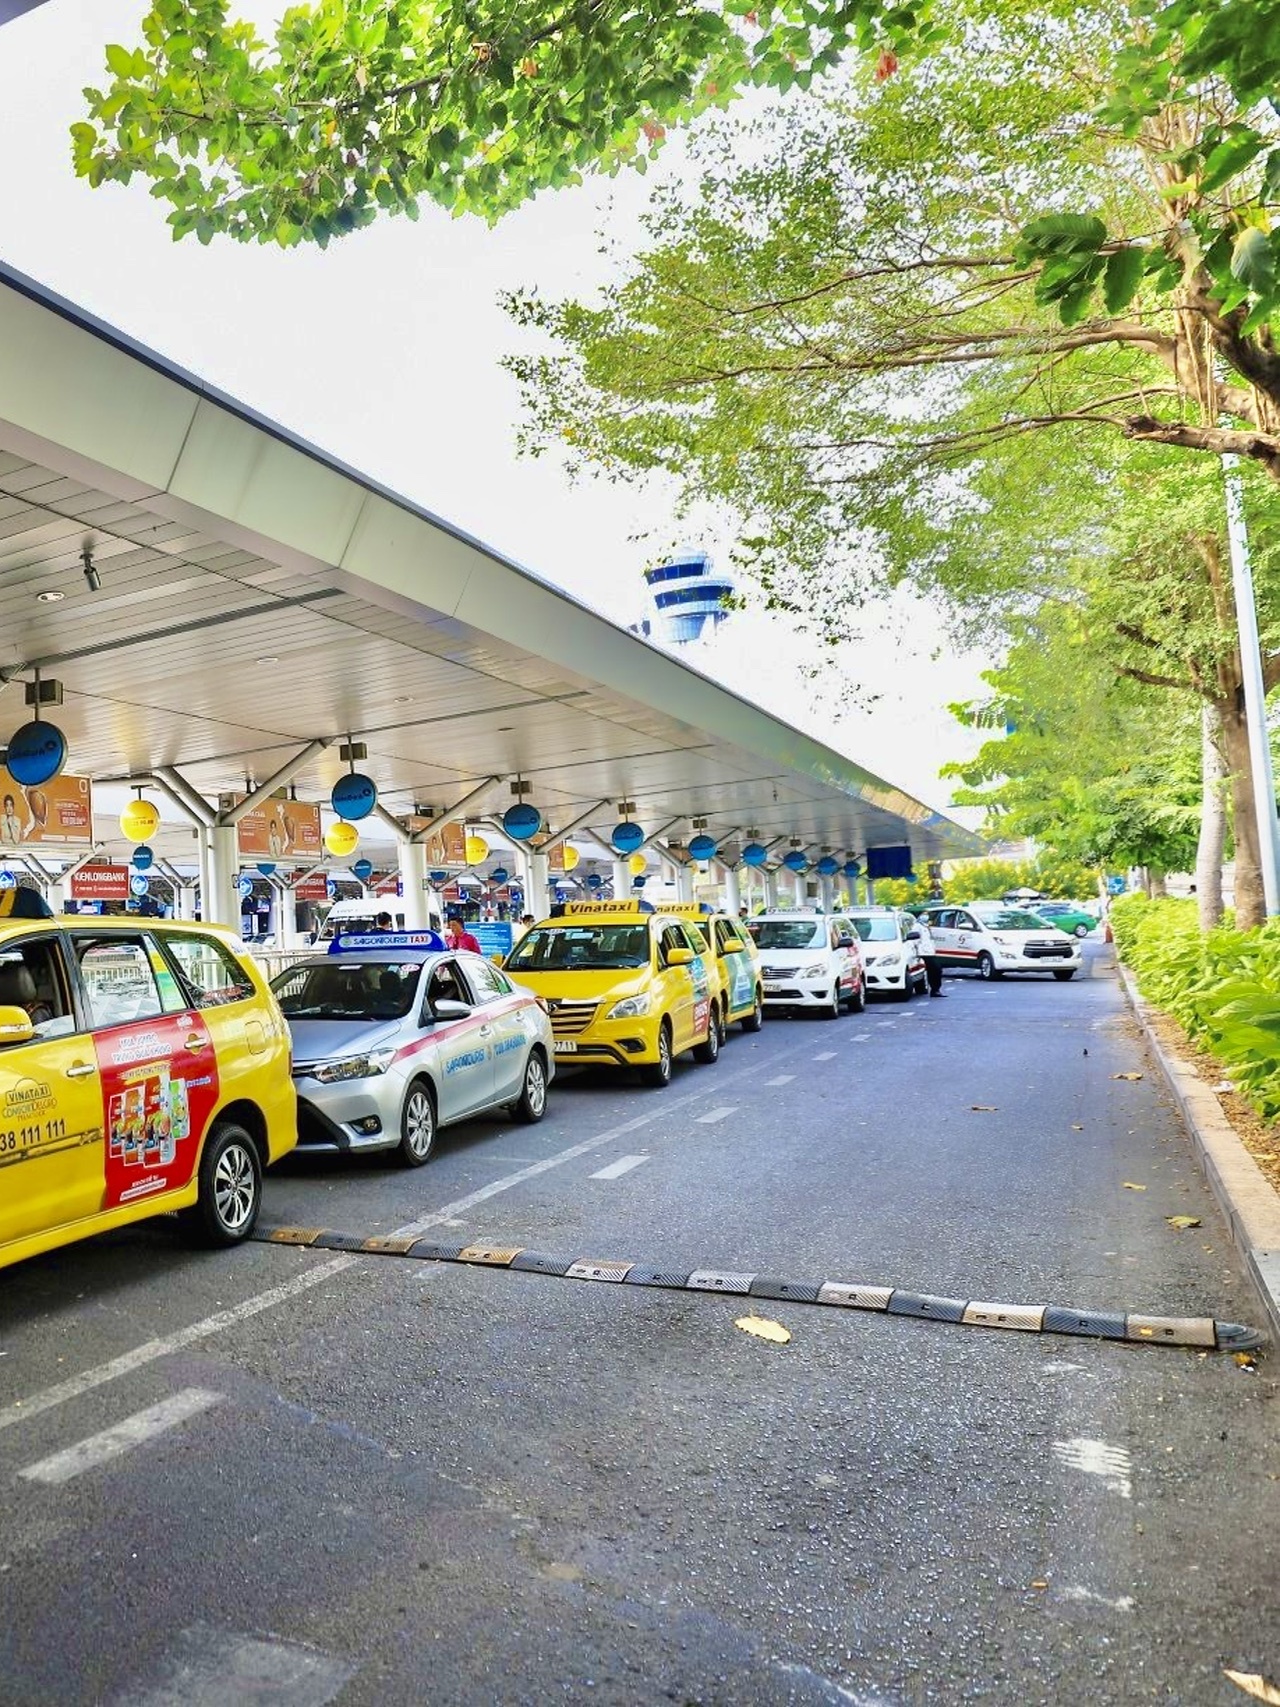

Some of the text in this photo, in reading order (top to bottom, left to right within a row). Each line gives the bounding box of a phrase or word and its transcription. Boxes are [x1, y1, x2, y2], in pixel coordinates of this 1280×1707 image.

[74, 871, 126, 883] KIENLONGBANK
[570, 902, 632, 914] Vinataxi
[410, 936, 429, 944] TAXI
[7, 1086, 49, 1103] VINATAXI
[0, 1131, 16, 1151] 38
[21, 1124, 41, 1146] 111
[46, 1118, 66, 1139] 111
